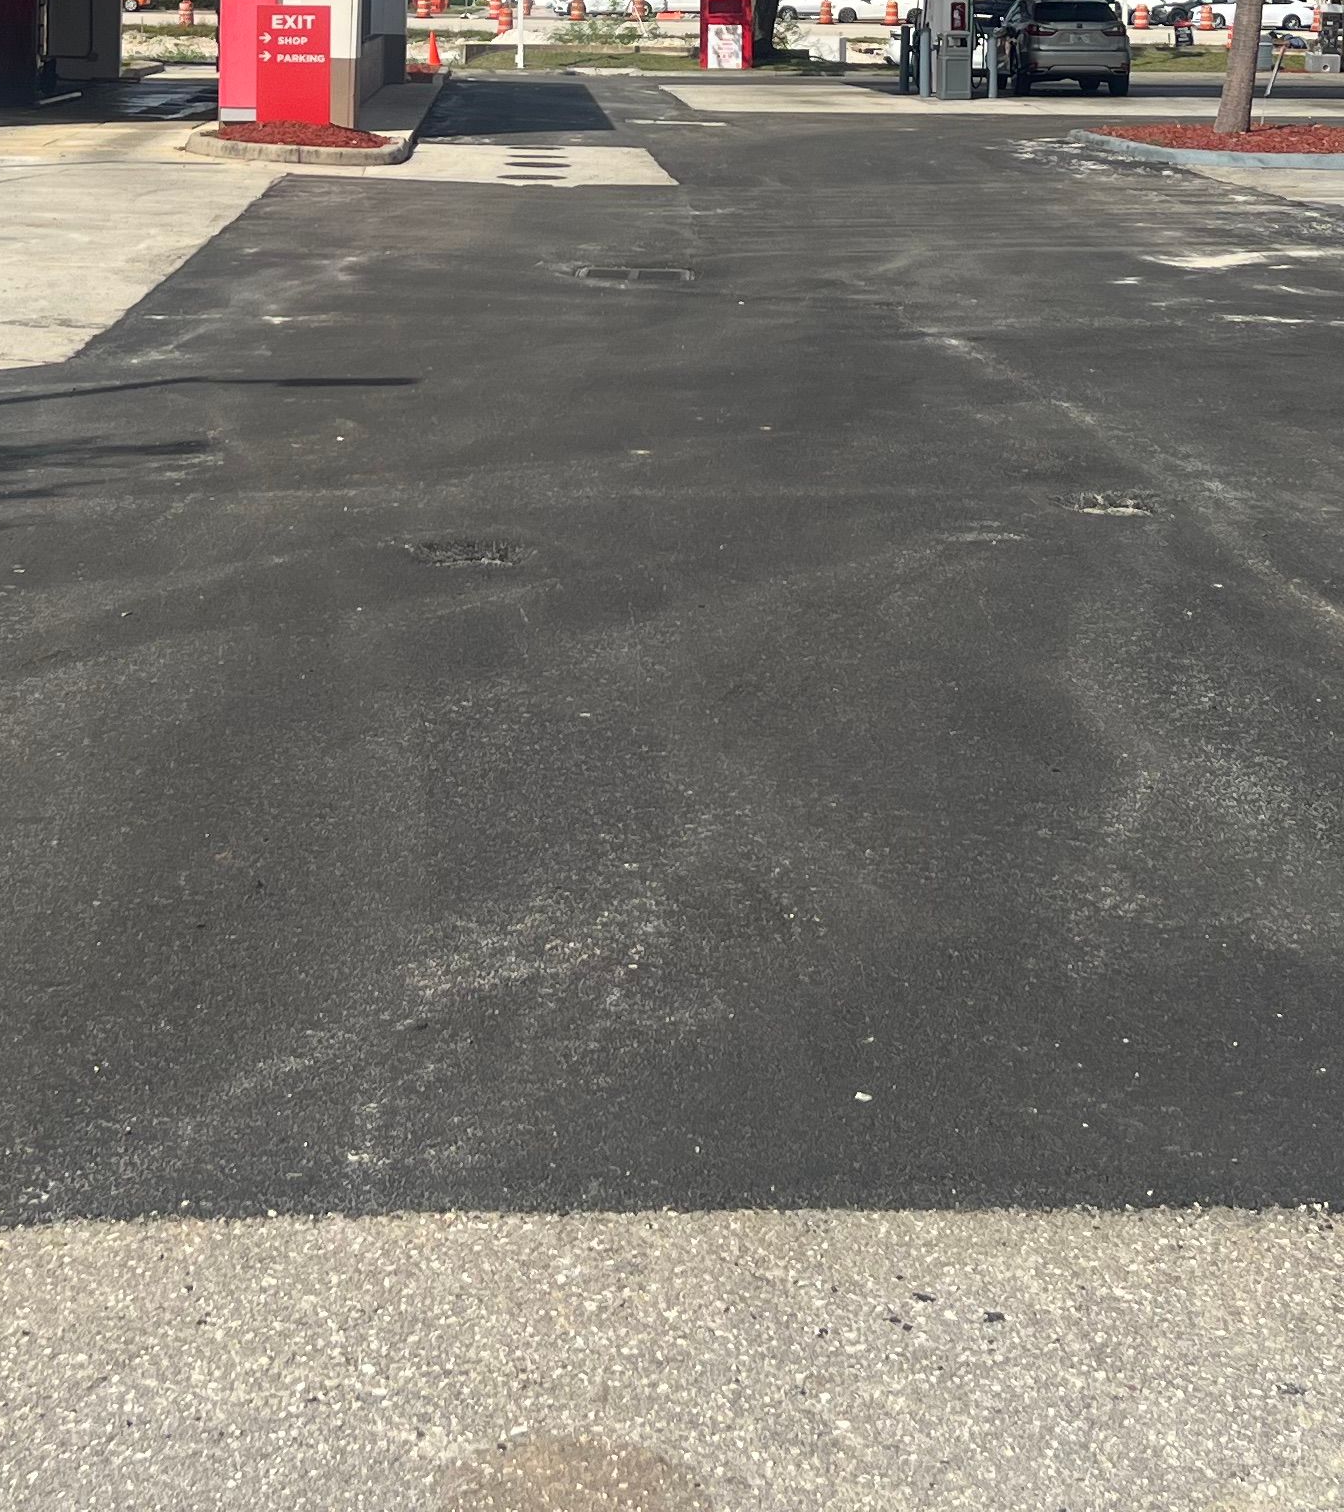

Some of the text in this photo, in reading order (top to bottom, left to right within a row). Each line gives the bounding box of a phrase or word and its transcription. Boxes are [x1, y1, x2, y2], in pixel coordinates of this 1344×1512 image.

[271, 14, 316, 29] EXIT
[277, 36, 308, 45] SHOP
[276, 53, 326, 63] PARKING
